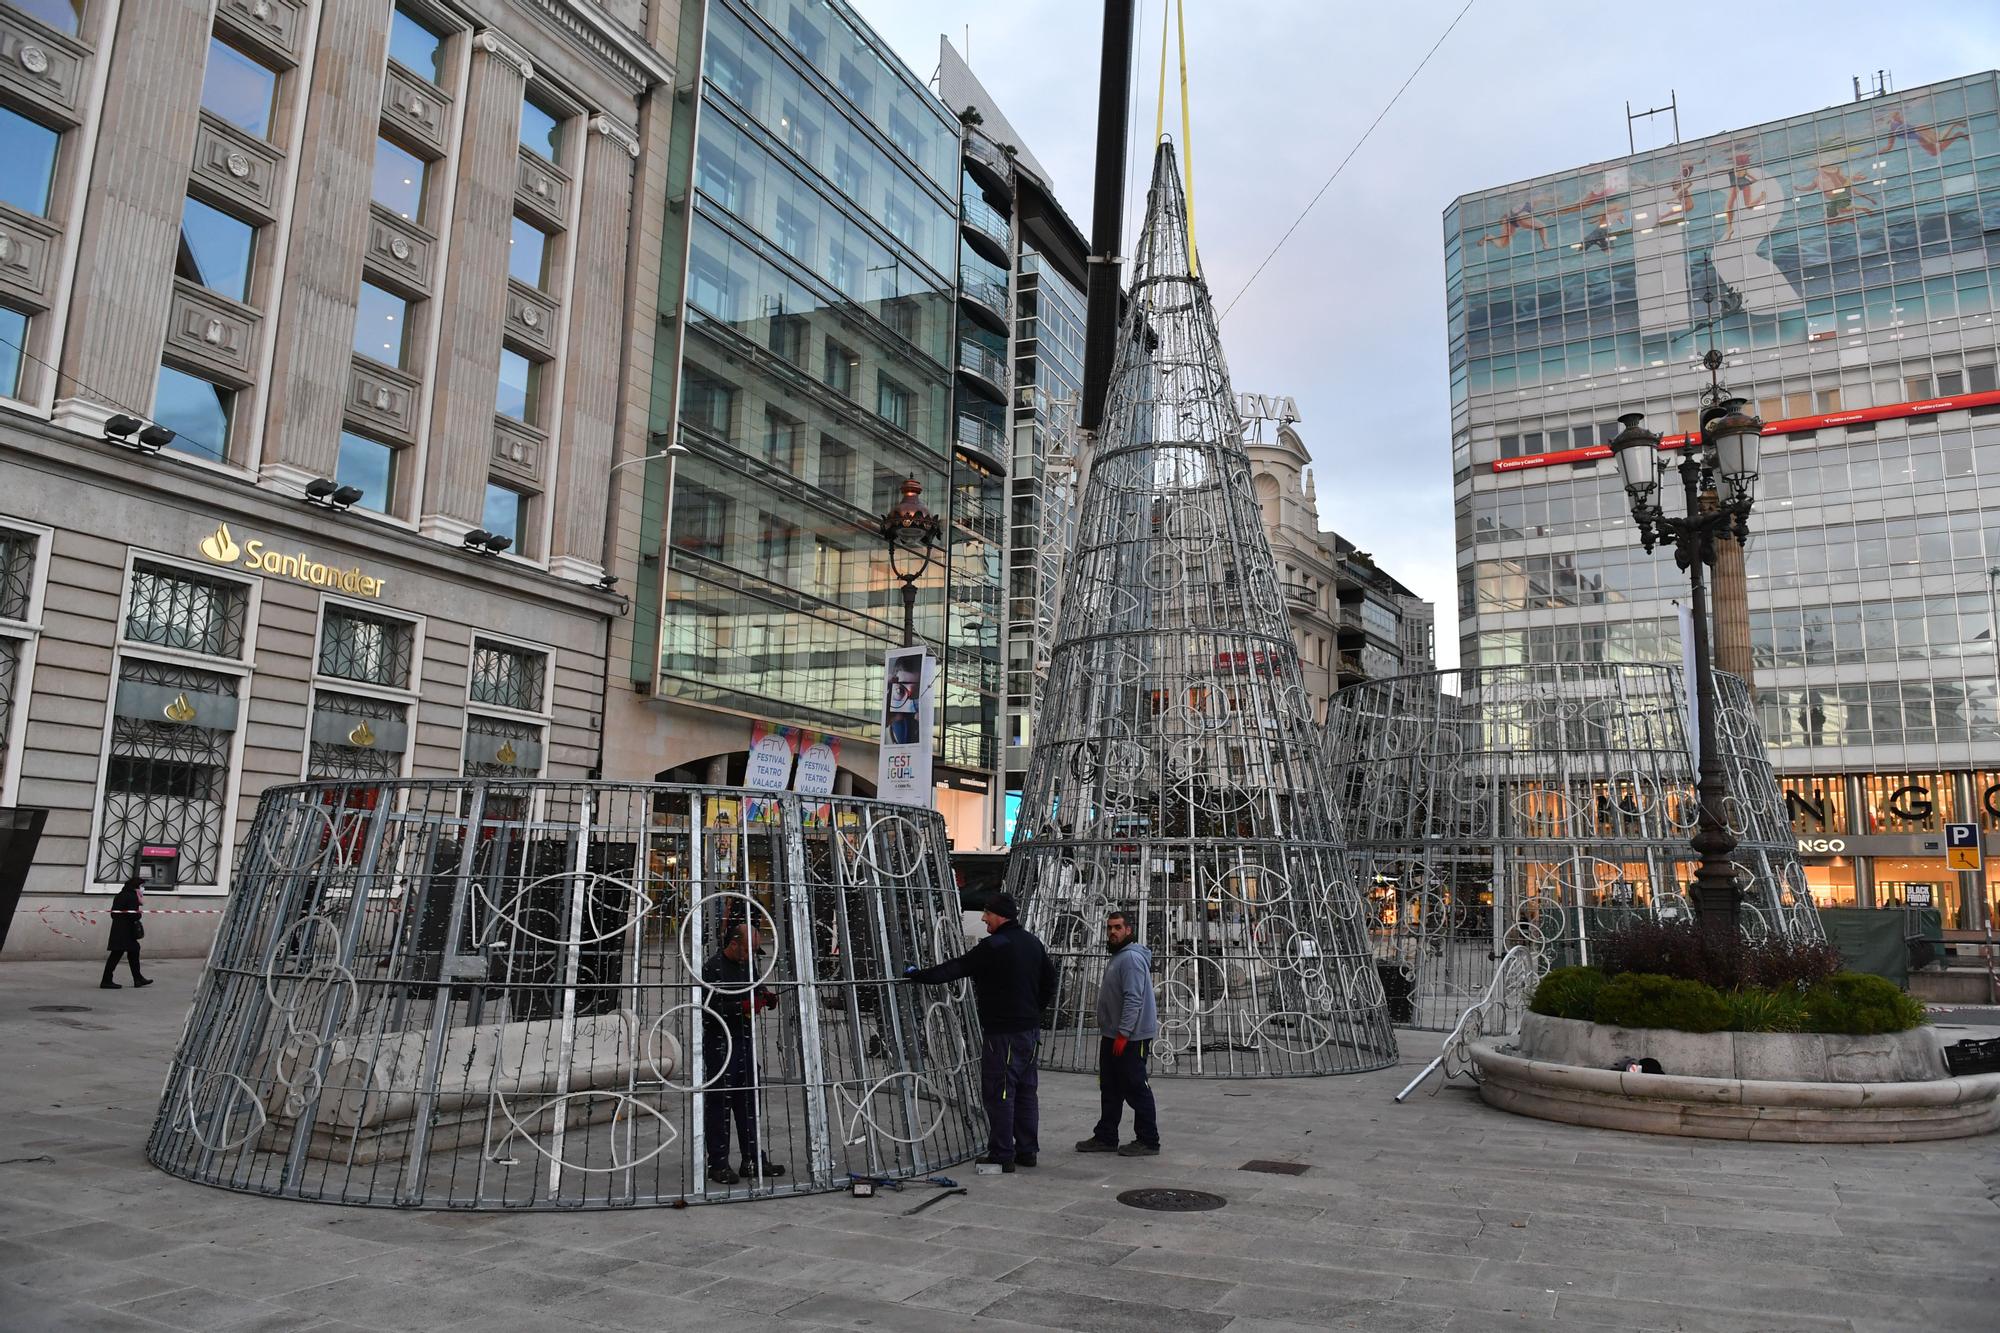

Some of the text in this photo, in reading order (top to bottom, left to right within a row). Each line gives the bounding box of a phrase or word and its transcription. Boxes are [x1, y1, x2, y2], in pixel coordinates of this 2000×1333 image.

[1233, 391, 1302, 423] BVA
[244, 539, 386, 598] Santander
[757, 753, 786, 765] FESTIVAL
[888, 755, 911, 768] FEST
[757, 765, 782, 777] TEATRO
[804, 761, 831, 772] FESTIVAL
[804, 773, 828, 784] TEATRO
[887, 767, 915, 779] IGUAL
[752, 777, 783, 790] VALACAR
[800, 784, 828, 794] VALACAR
[1953, 827, 1970, 845] P
[1799, 838, 1846, 853] NGO
[1906, 885, 1929, 895] BLACK
[1906, 894, 1931, 903] FRIDAY
